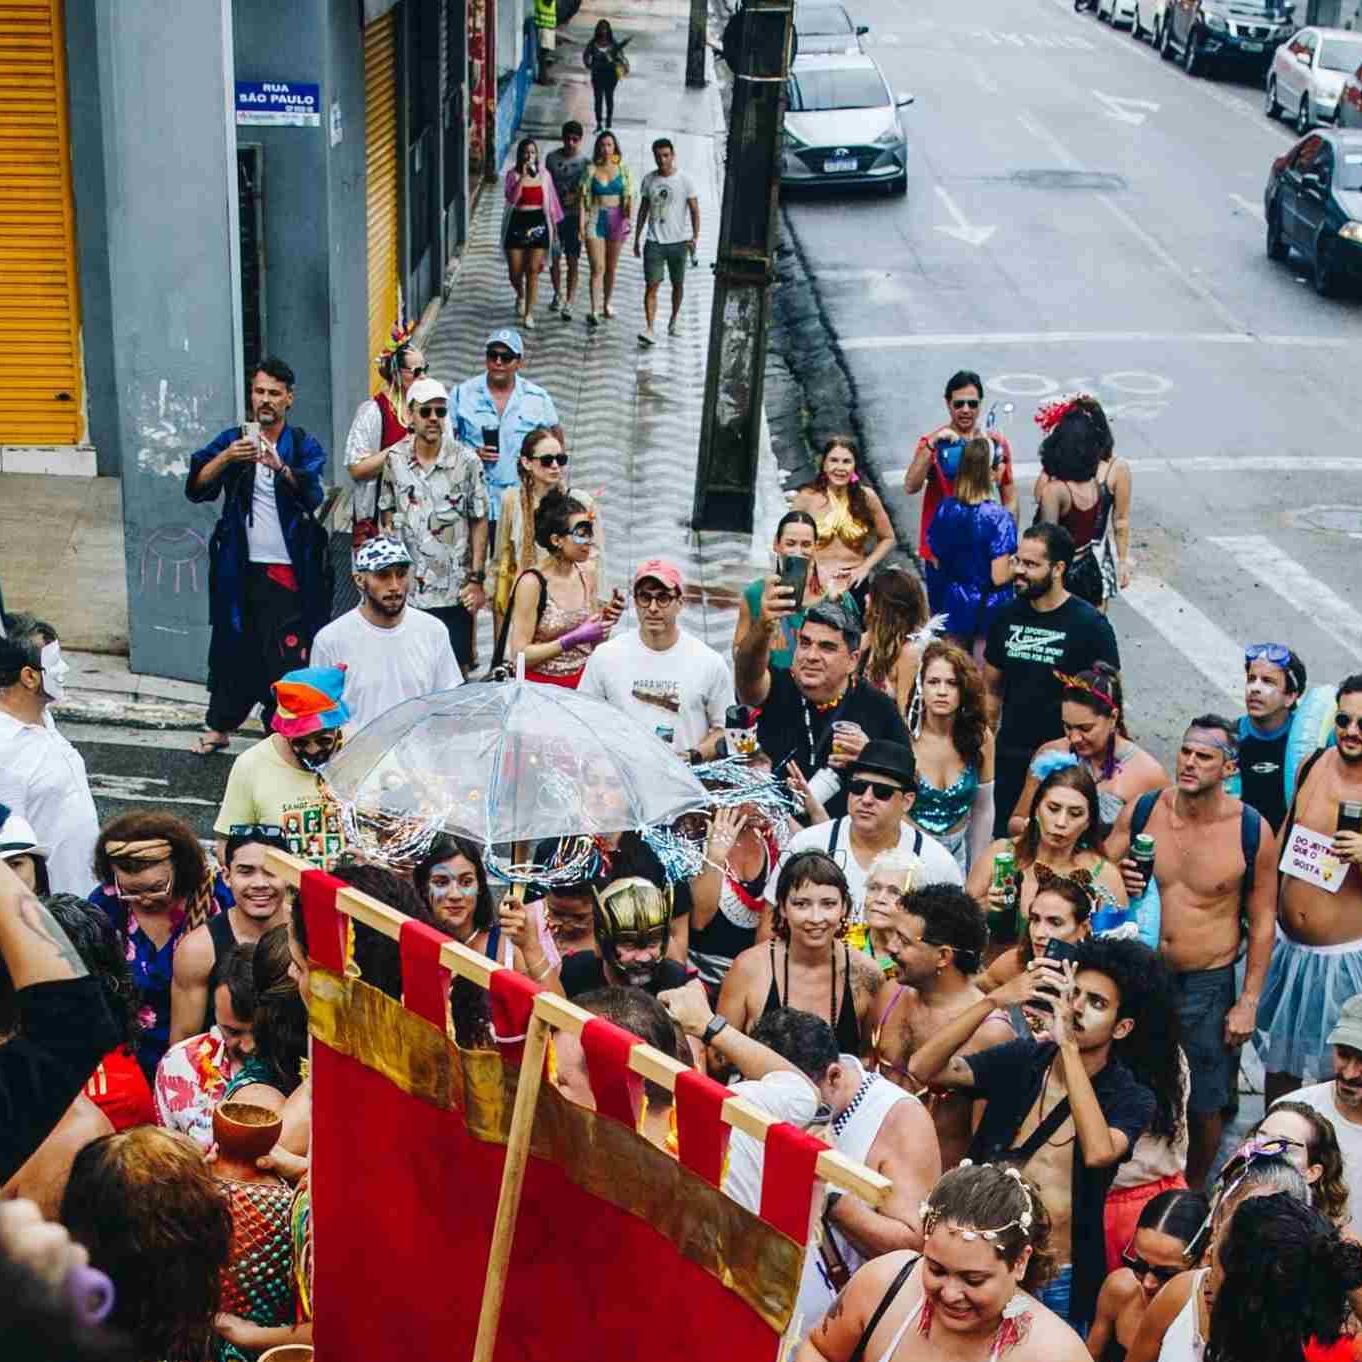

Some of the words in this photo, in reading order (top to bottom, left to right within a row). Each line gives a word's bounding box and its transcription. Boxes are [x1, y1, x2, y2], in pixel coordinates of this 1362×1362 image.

[262, 83, 290, 93] RUA
[239, 93, 267, 103] SÃO
[270, 94, 314, 105] PAULO
